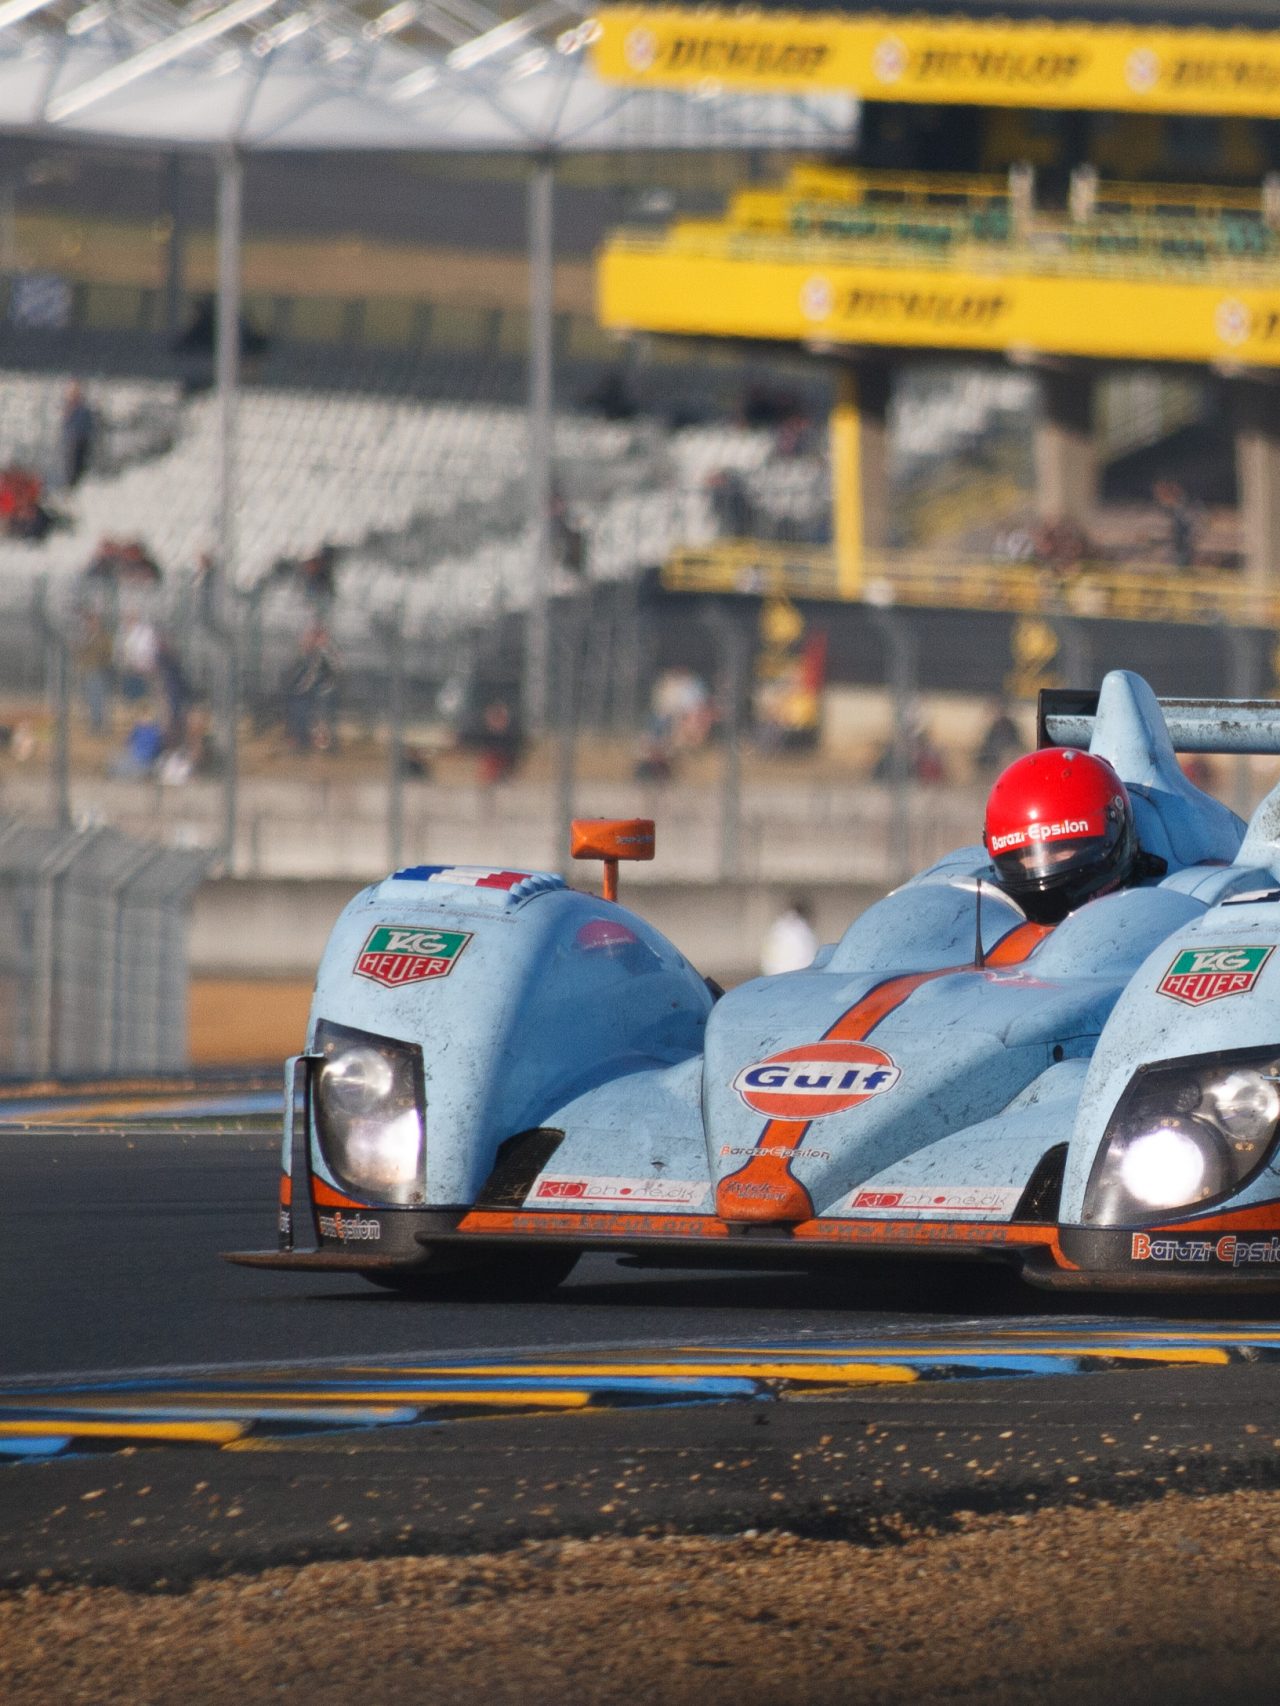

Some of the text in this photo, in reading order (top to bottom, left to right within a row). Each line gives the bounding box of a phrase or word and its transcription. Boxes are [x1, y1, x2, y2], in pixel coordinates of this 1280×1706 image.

[385, 930, 448, 954] TAG
[362, 954, 445, 982] HEUER
[1189, 950, 1250, 973] TAG
[1167, 973, 1248, 1000] HEUER
[744, 1065, 893, 1091] Gulf
